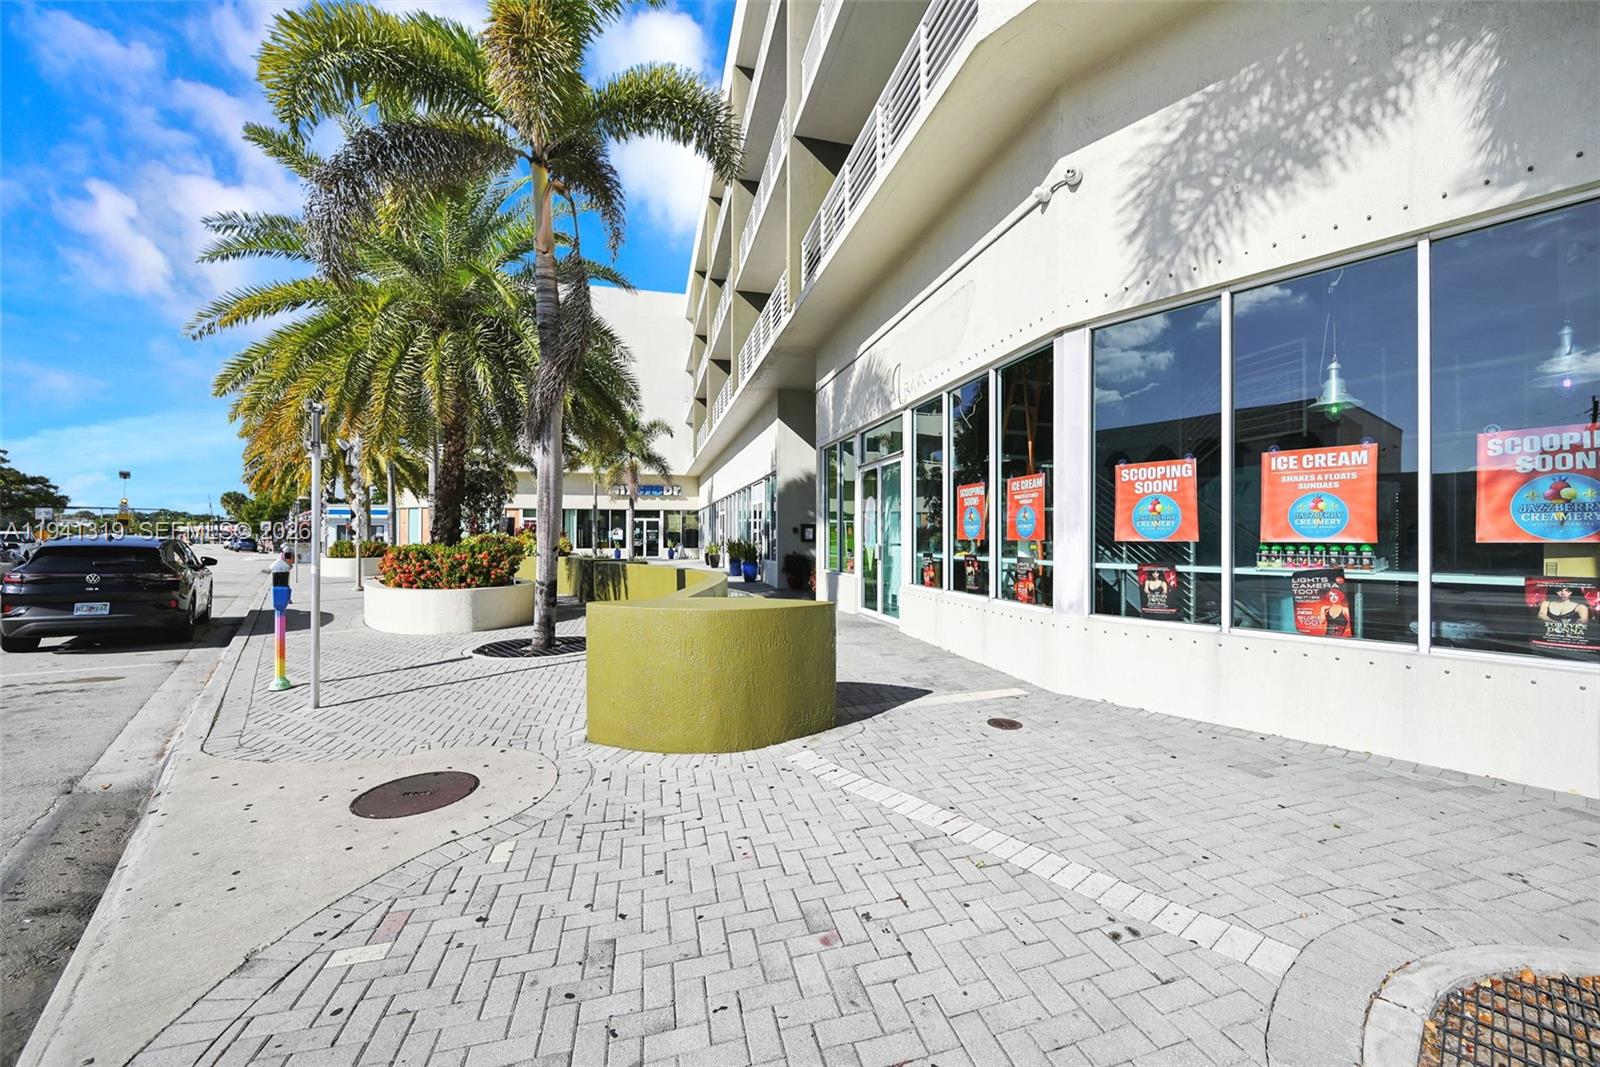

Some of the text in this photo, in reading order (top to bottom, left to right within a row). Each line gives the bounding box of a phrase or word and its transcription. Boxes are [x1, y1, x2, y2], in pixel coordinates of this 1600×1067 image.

[1271, 450, 1368, 470] ICE CREAM
[1516, 451, 1600, 473] SOON
[1121, 464, 1192, 481] SCOOPING
[1281, 474, 1315, 483] SHAKES
[1325, 472, 1357, 480] FLOATS
[1021, 477, 1043, 489] CREAM
[1134, 479, 1178, 494] SOON!
[1298, 481, 1339, 489] SUNDAES
[960, 486, 984, 498] SCOOPING
[1294, 518, 1342, 526] CREAMERY
[1520, 511, 1600, 522] CREAMERY
